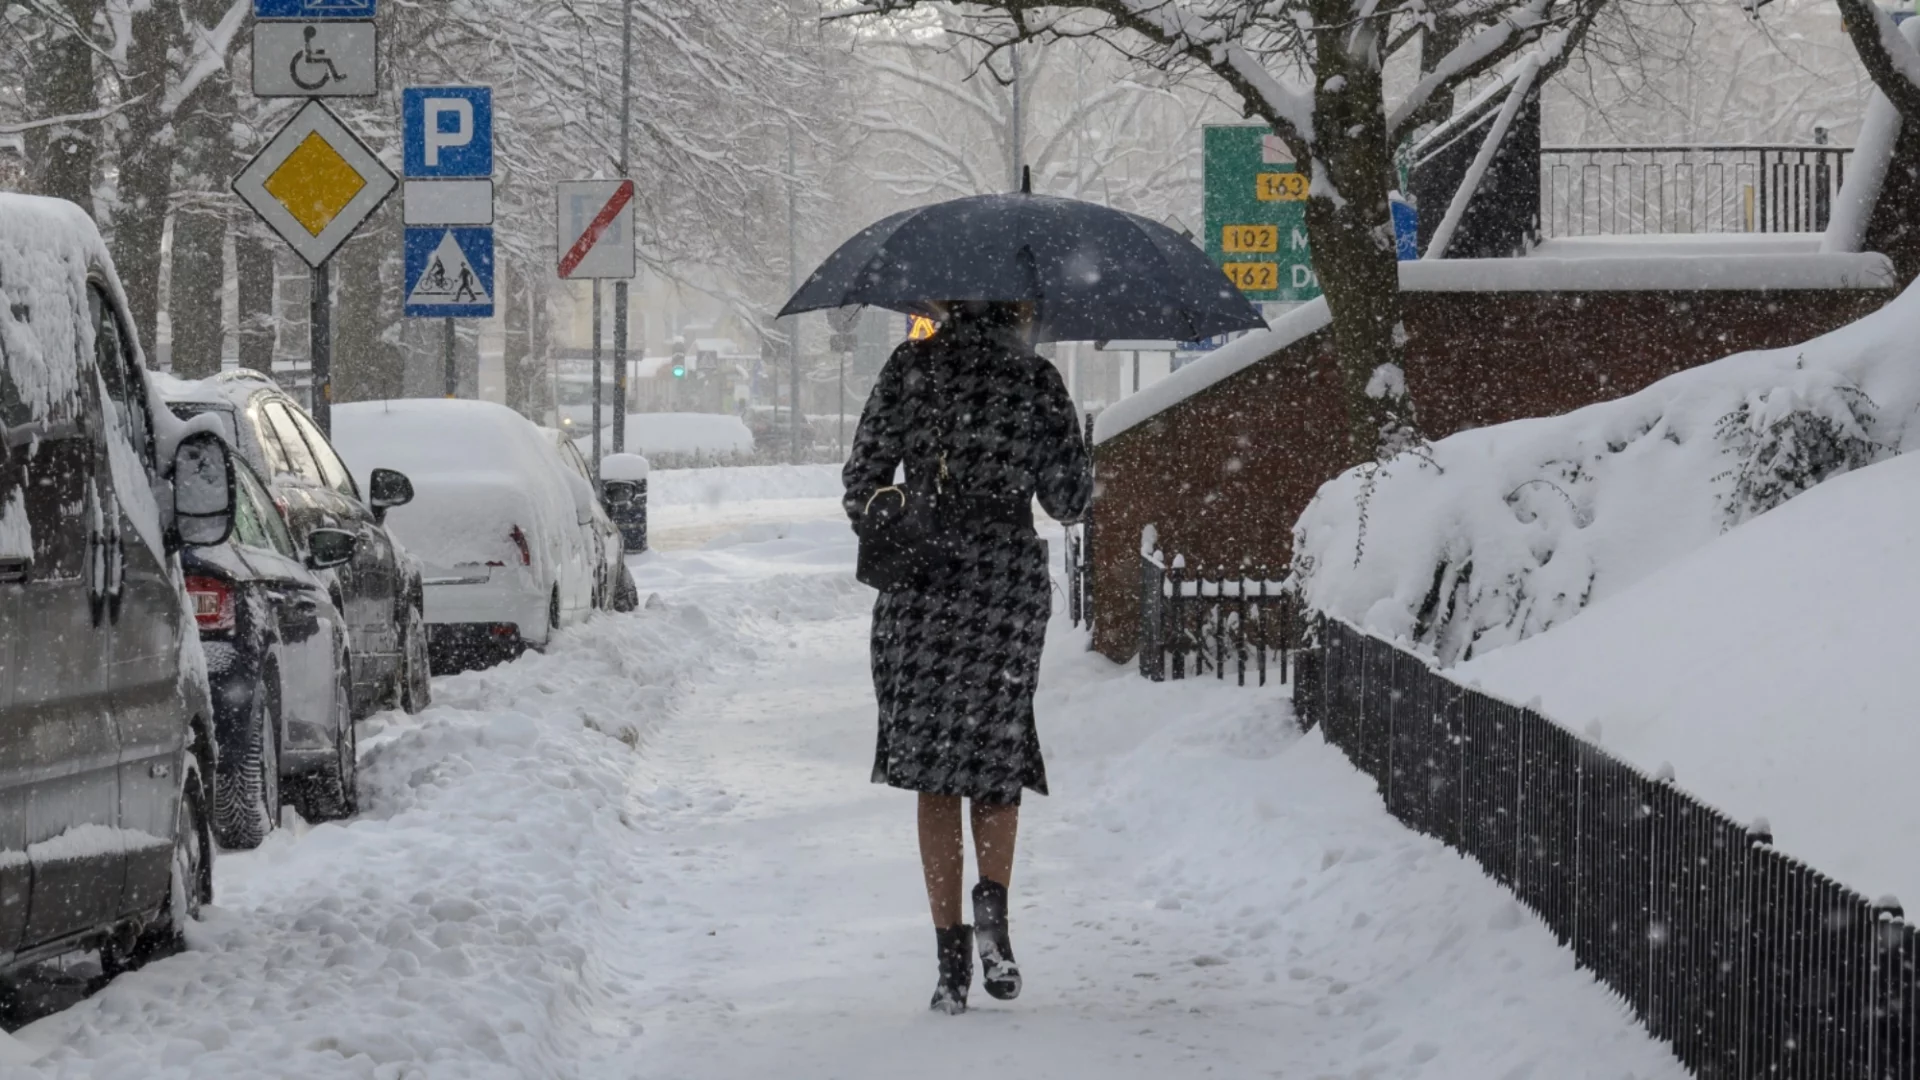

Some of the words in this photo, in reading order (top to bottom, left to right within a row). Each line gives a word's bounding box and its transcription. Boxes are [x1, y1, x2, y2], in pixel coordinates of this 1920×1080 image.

[424, 97, 473, 166] P
[1266, 176, 1303, 196] 163
[1231, 228, 1270, 248] 102
[1231, 266, 1270, 286] 162
